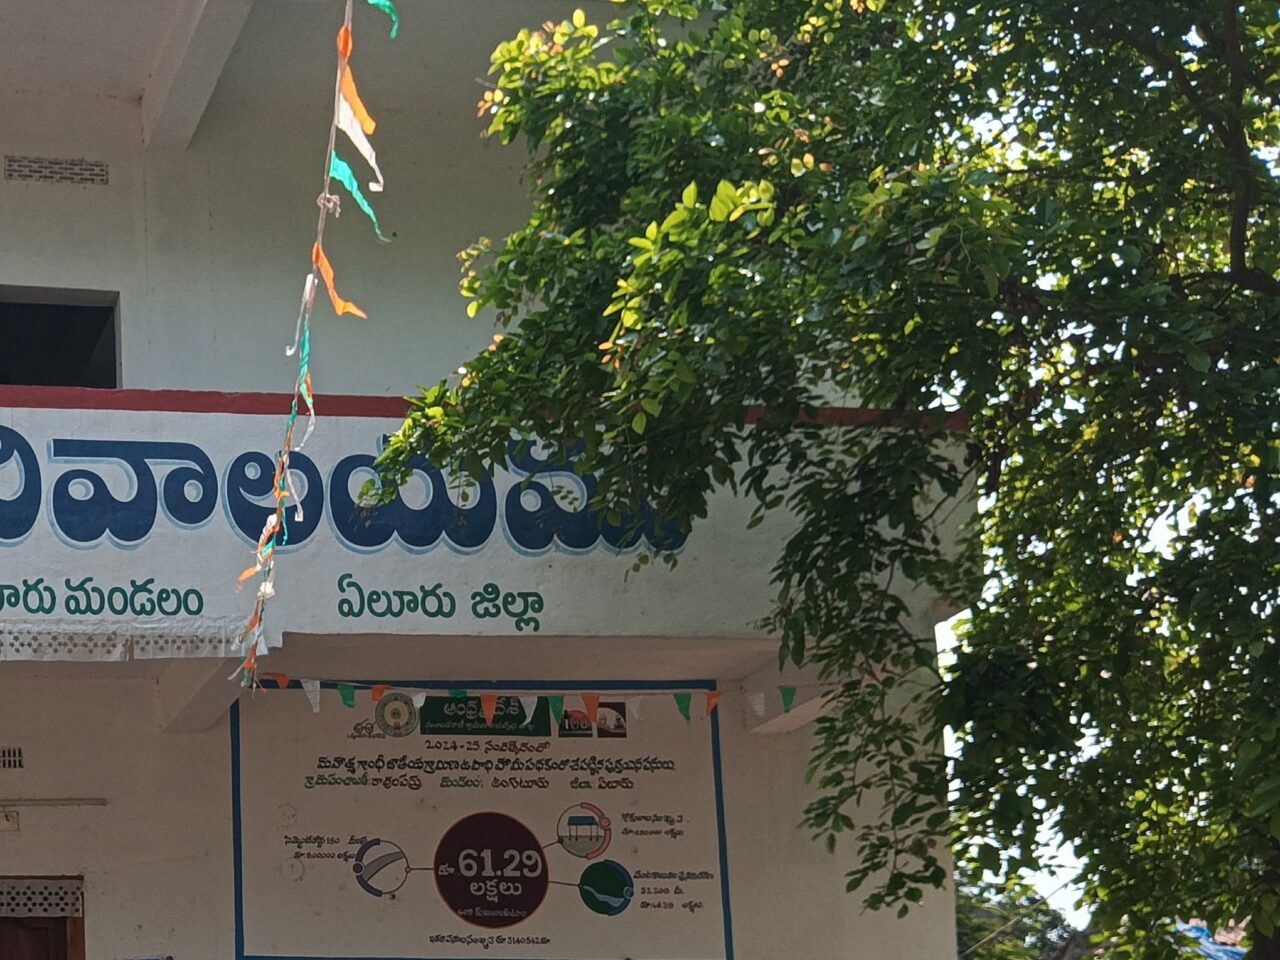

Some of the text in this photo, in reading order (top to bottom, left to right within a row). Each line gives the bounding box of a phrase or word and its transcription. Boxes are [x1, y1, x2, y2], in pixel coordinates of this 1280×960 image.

[64, 575, 204, 616] మండలం
[337, 572, 456, 619] ఏలూరు
[471, 581, 544, 632] జిల్లా
[458, 848, 543, 878] 61.29
[470, 878, 522, 903] లక్షలు
